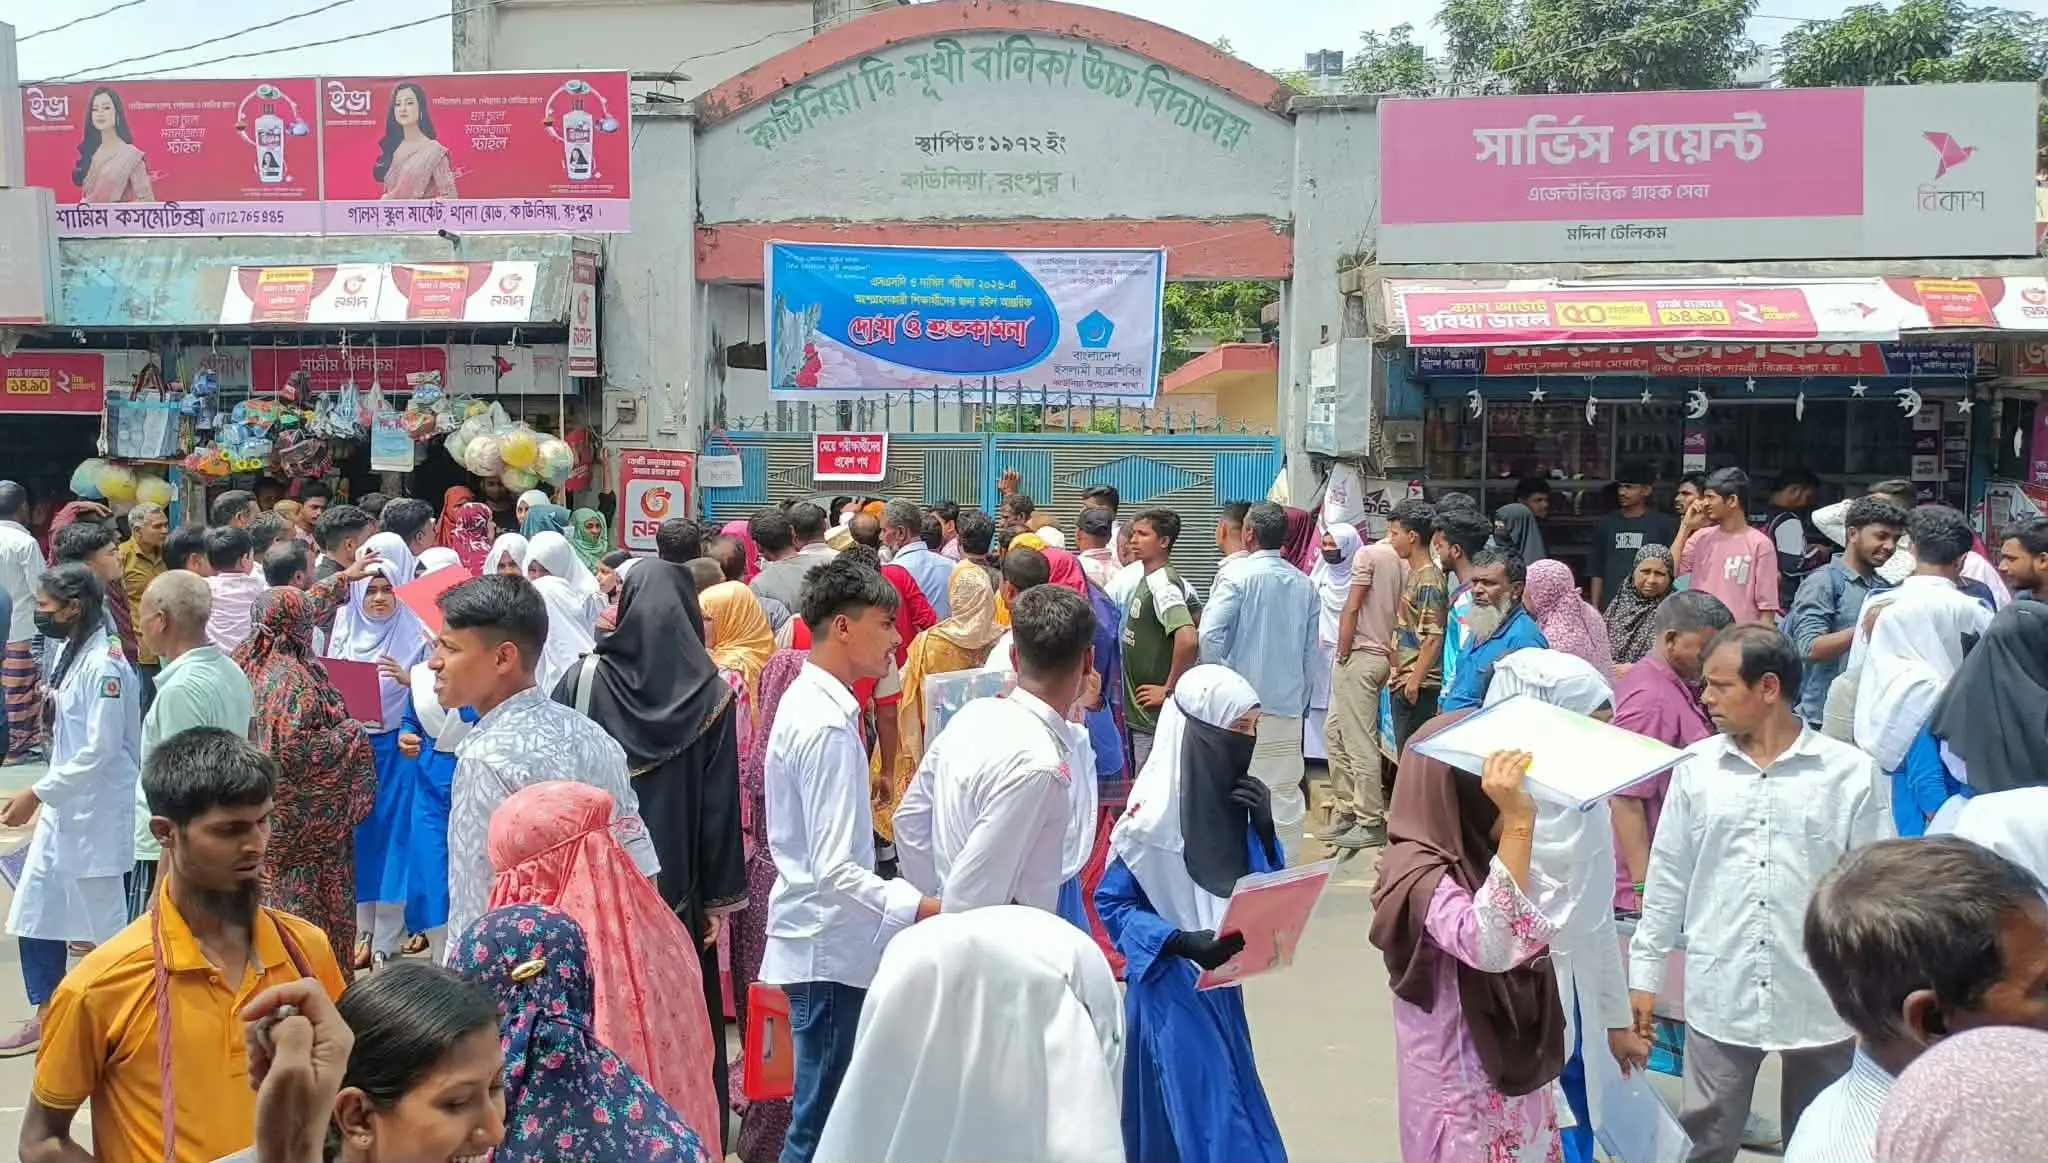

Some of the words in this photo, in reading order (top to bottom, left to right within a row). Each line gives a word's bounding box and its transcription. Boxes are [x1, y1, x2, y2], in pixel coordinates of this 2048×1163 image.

[27, 87, 69, 120] ইভা
[328, 81, 371, 114] ইভা
[744, 71, 862, 151] কাউনিয়া
[971, 34, 1078, 88] বালিকা
[1082, 41, 1138, 98] উচ্চ
[1135, 64, 1252, 152] বিদ্যালয়
[989, 137, 1042, 154] ১৯৭২
[1047, 131, 1067, 155] ইং
[1473, 113, 1614, 168] সার্ভিস
[1628, 111, 1767, 165] পয়েন্ট
[994, 169, 1062, 197] রংপুর
[1527, 181, 1626, 203] এজেন্টভিত্তিক
[1631, 184, 1672, 201] গ্রাহক
[1676, 182, 1710, 200] সেবা
[1917, 184, 1986, 211] বিকাশ
[56, 202, 108, 230] শামিম
[383, 205, 404, 227] স্কুল
[450, 205, 477, 225] থানা
[1566, 225, 1606, 243] মদিনা
[1610, 222, 1669, 242] টেলিকম
[1418, 311, 1482, 332] সুবিধা
[1487, 313, 1552, 329] ডাবল
[1562, 304, 1607, 324] ৫০
[1667, 308, 1726, 323] ১৪.৯০
[1736, 299, 1764, 324] ২
[848, 313, 904, 345] দোয়া
[903, 310, 922, 338] ও
[926, 315, 1036, 348] শুভকামনা
[1072, 351, 1121, 361] বাংলাদেশ
[464, 361, 495, 376] বিকাশ
[1054, 363, 1092, 377] ইসলামী
[11, 379, 49, 392] ১৪.৯০
[56, 368, 72, 394] ২
[856, 455, 869, 469] পথ
[632, 520, 661, 537] নগ
[1723, 555, 1752, 585] Hi
